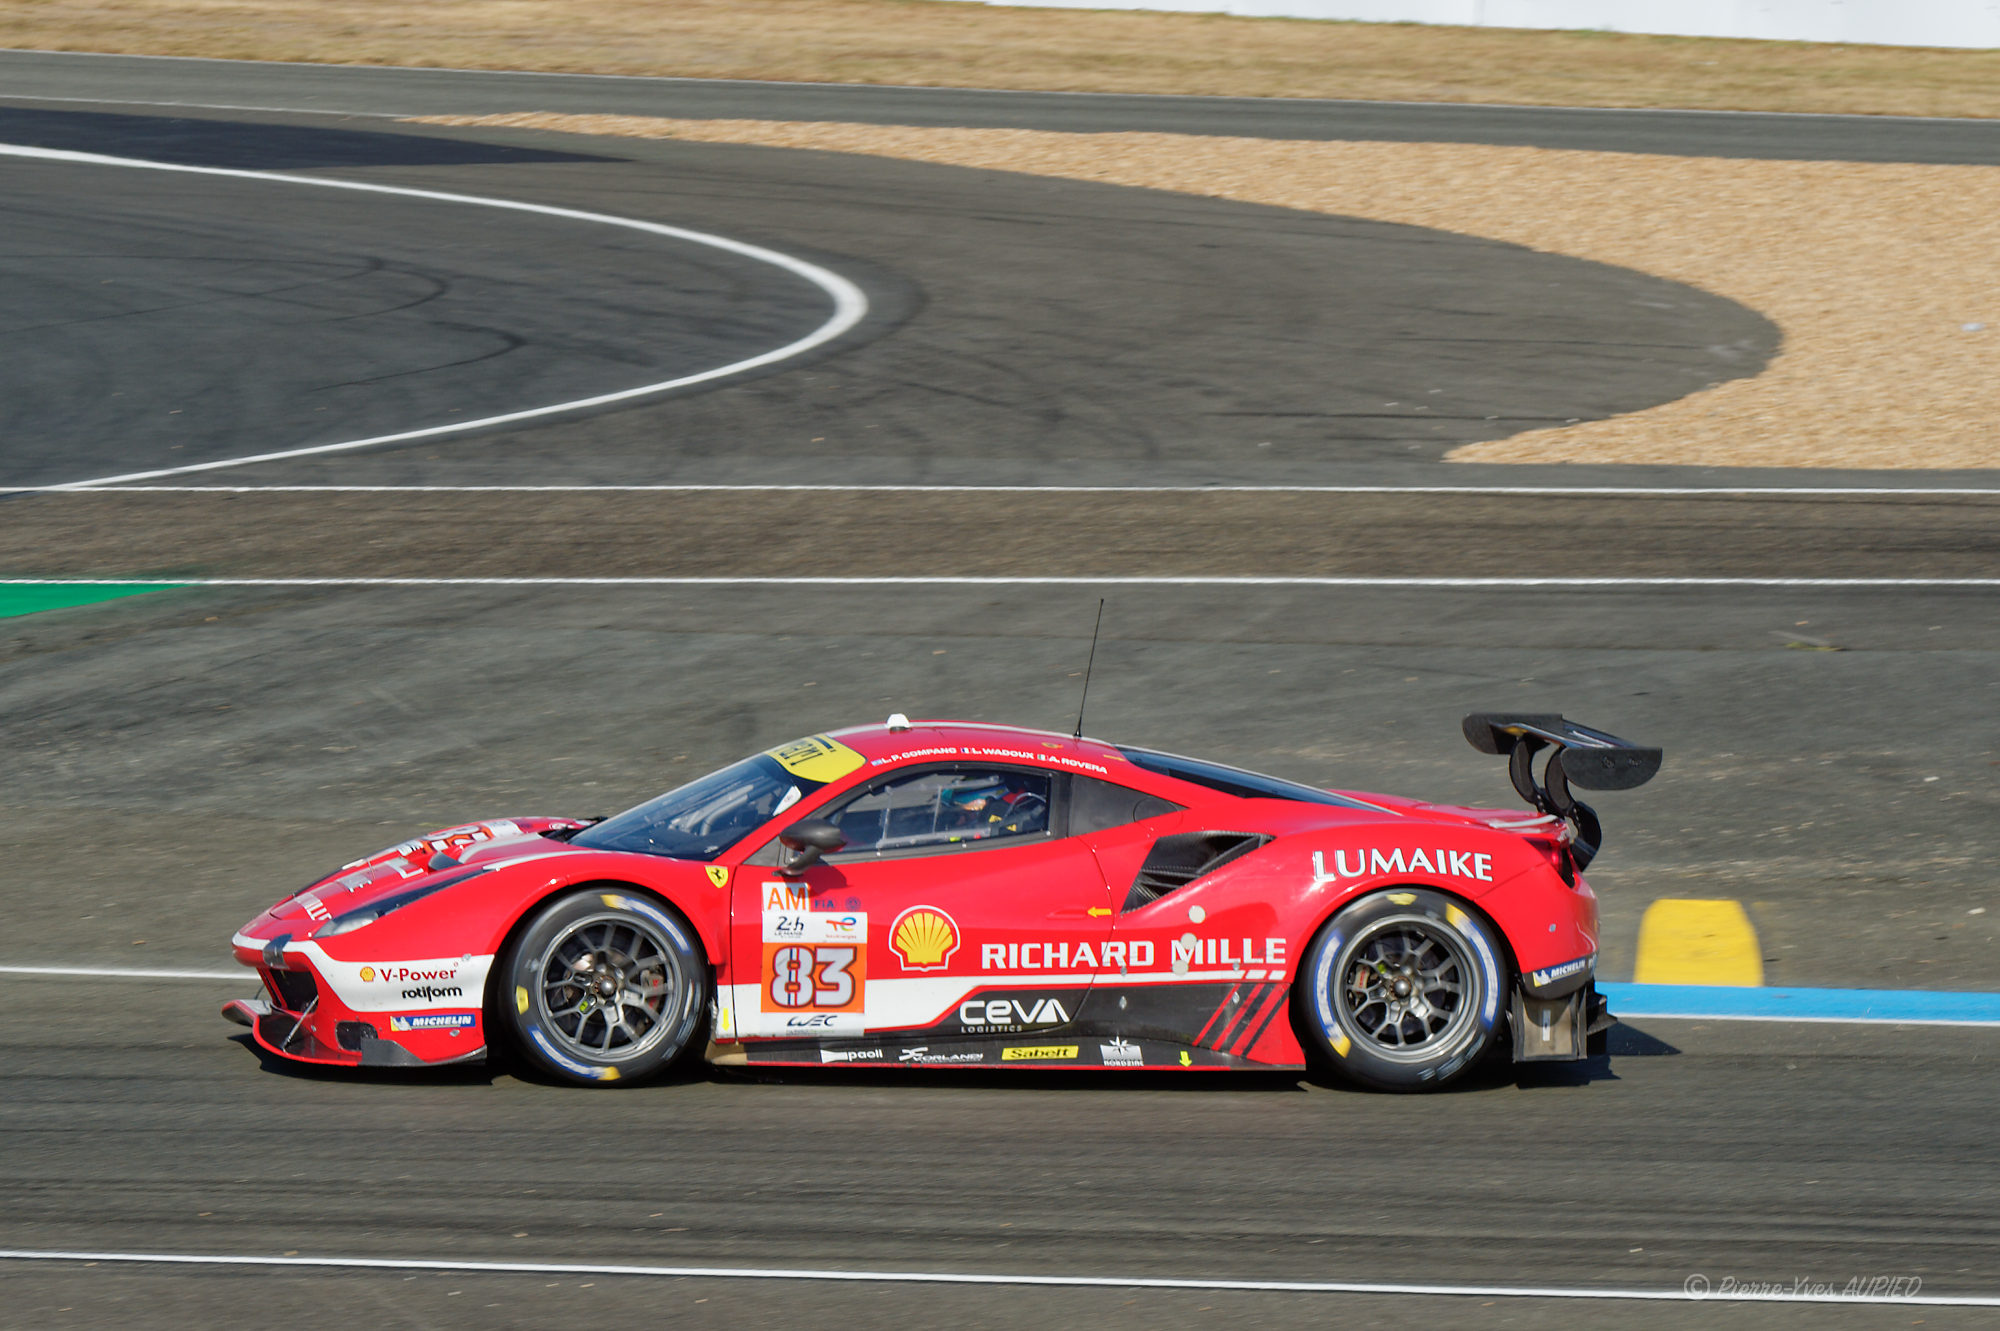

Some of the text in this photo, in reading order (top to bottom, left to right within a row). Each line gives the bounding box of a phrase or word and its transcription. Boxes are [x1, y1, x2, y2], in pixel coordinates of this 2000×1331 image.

[982, 748, 1034, 759] WADOUX
[1061, 758, 1108, 774] ROVERA
[1312, 848, 1493, 882] LUMAIKE
[767, 887, 806, 910] AM
[814, 899, 835, 909] FIA
[981, 938, 1287, 969] RICHARD MILLE
[380, 968, 456, 982] V-Power
[1551, 959, 1586, 978] MICHELIN
[770, 945, 858, 1009] 83
[402, 986, 462, 1002] rotiform
[412, 1016, 472, 1027] MICHELIN
[787, 1014, 838, 1027] WEC
[961, 1024, 1023, 1033] LOGISTICS
[847, 1049, 883, 1062] paoli
[1010, 1048, 1069, 1059] Sabelt
